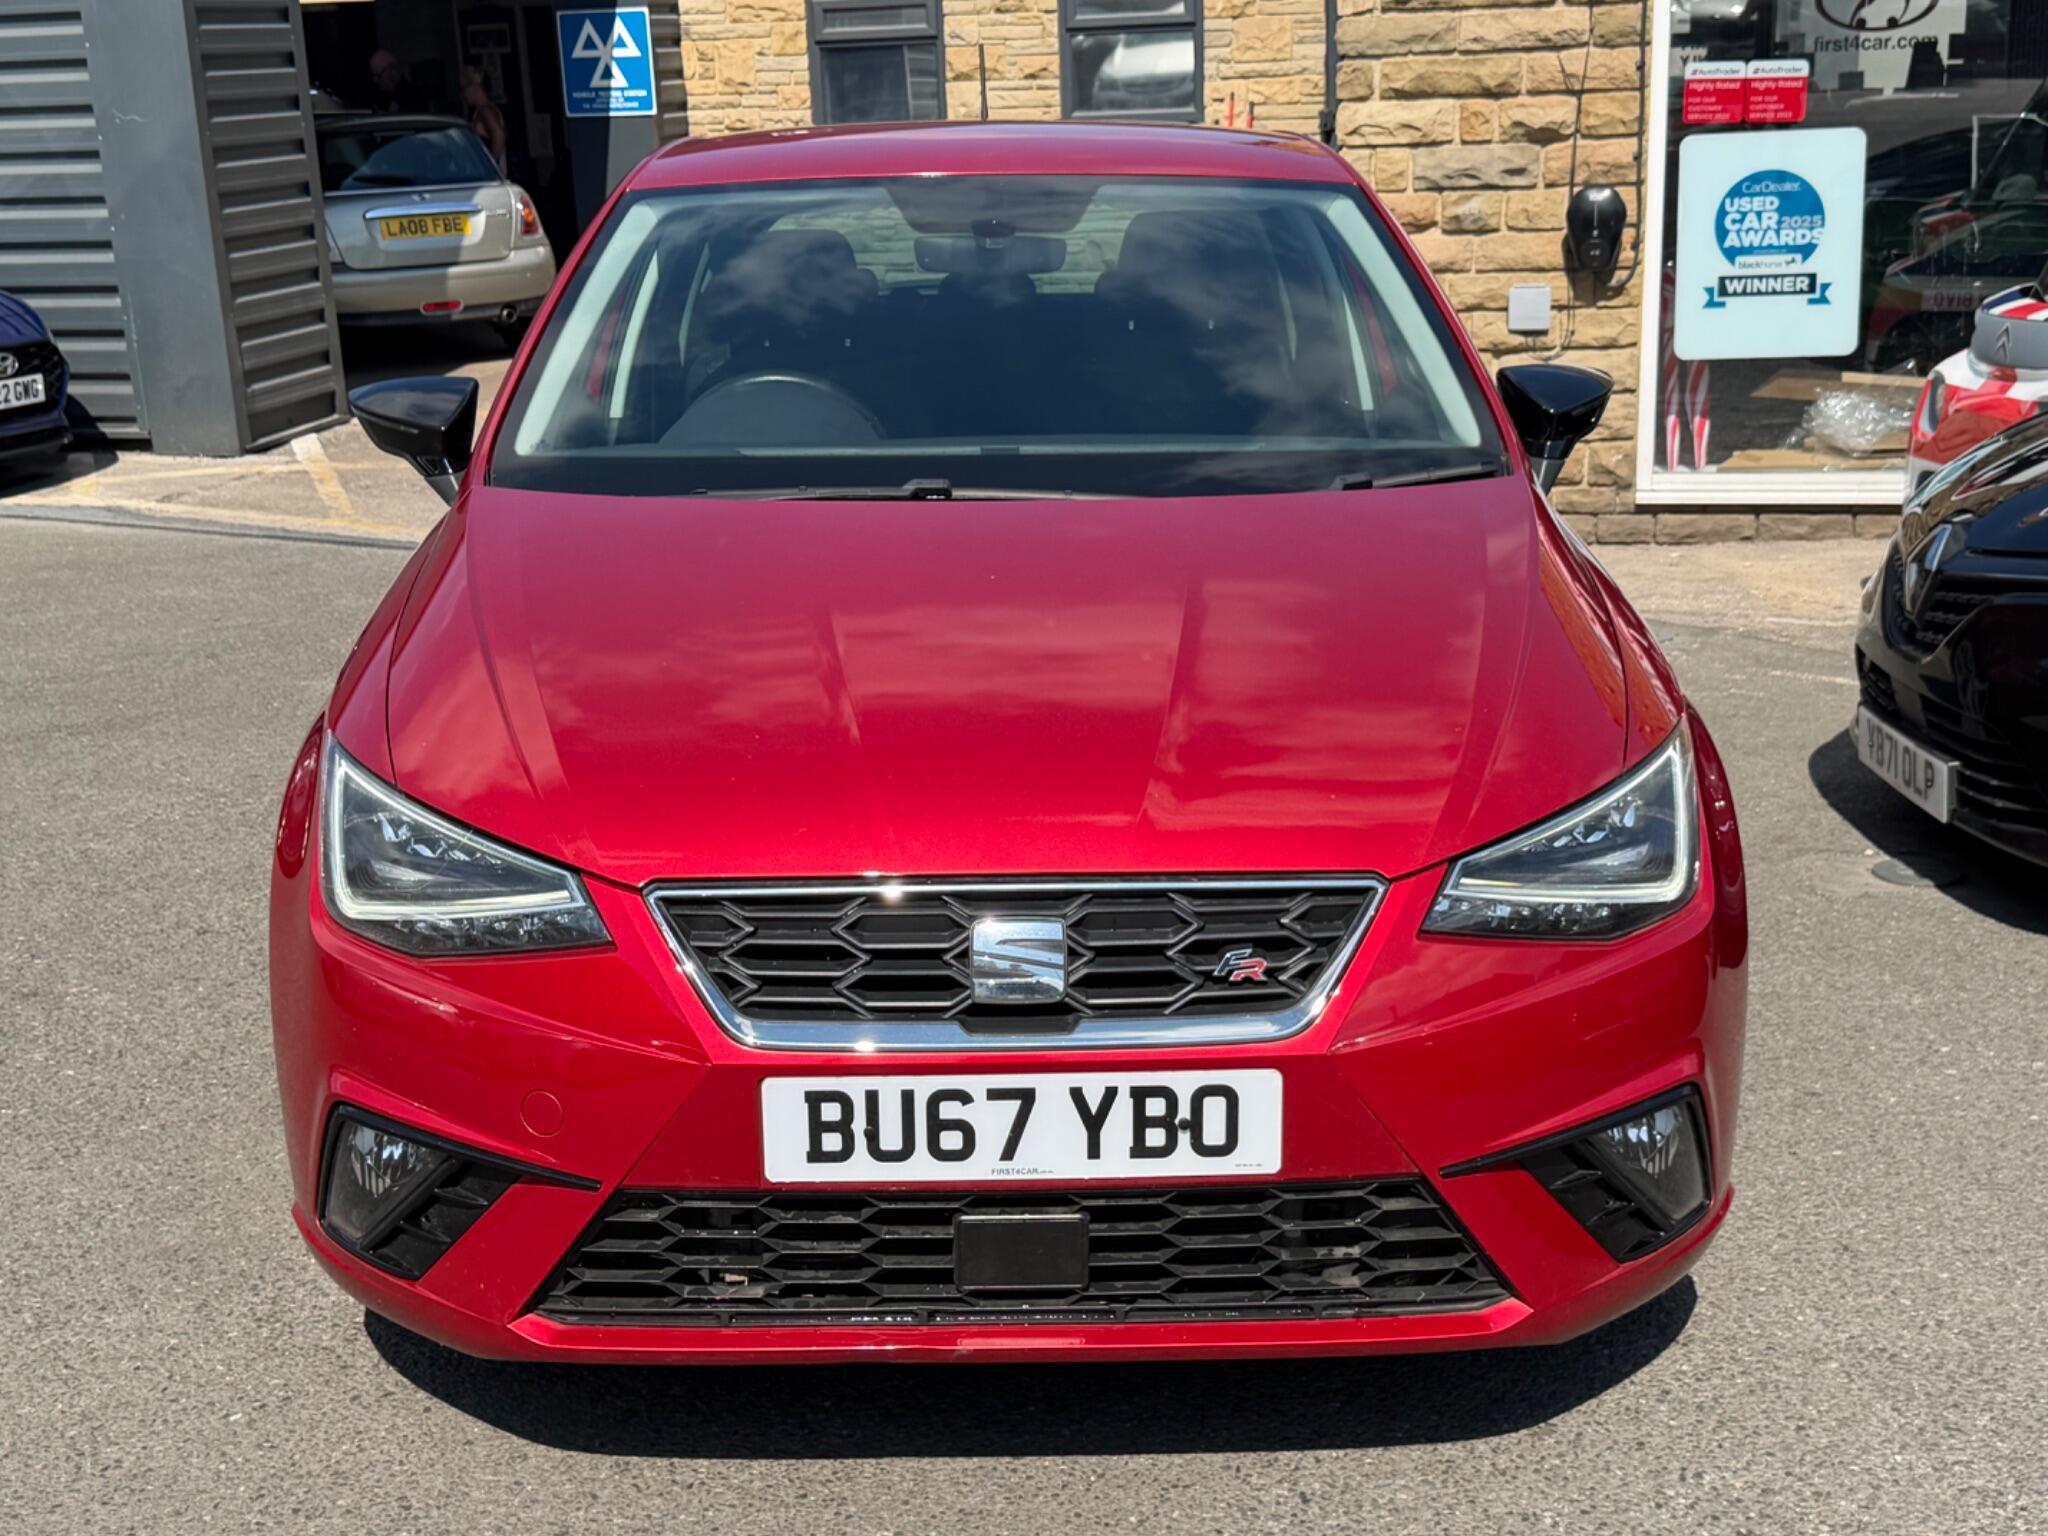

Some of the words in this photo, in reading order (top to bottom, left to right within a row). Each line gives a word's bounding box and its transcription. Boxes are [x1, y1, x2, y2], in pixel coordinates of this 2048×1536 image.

[1724, 195, 1780, 212] USED
[386, 217, 429, 237] LA08
[432, 216, 464, 234] FBE
[1723, 211, 1778, 231] CAR
[1780, 214, 1823, 229] 2025
[1722, 227, 1824, 249] AWARDS
[1724, 276, 1810, 294] WINNER
[1902, 745, 1935, 801] OLP
[1212, 948, 1268, 982] FR
[804, 1087, 1037, 1164] BU67
[1069, 1083, 1240, 1161] YBO
